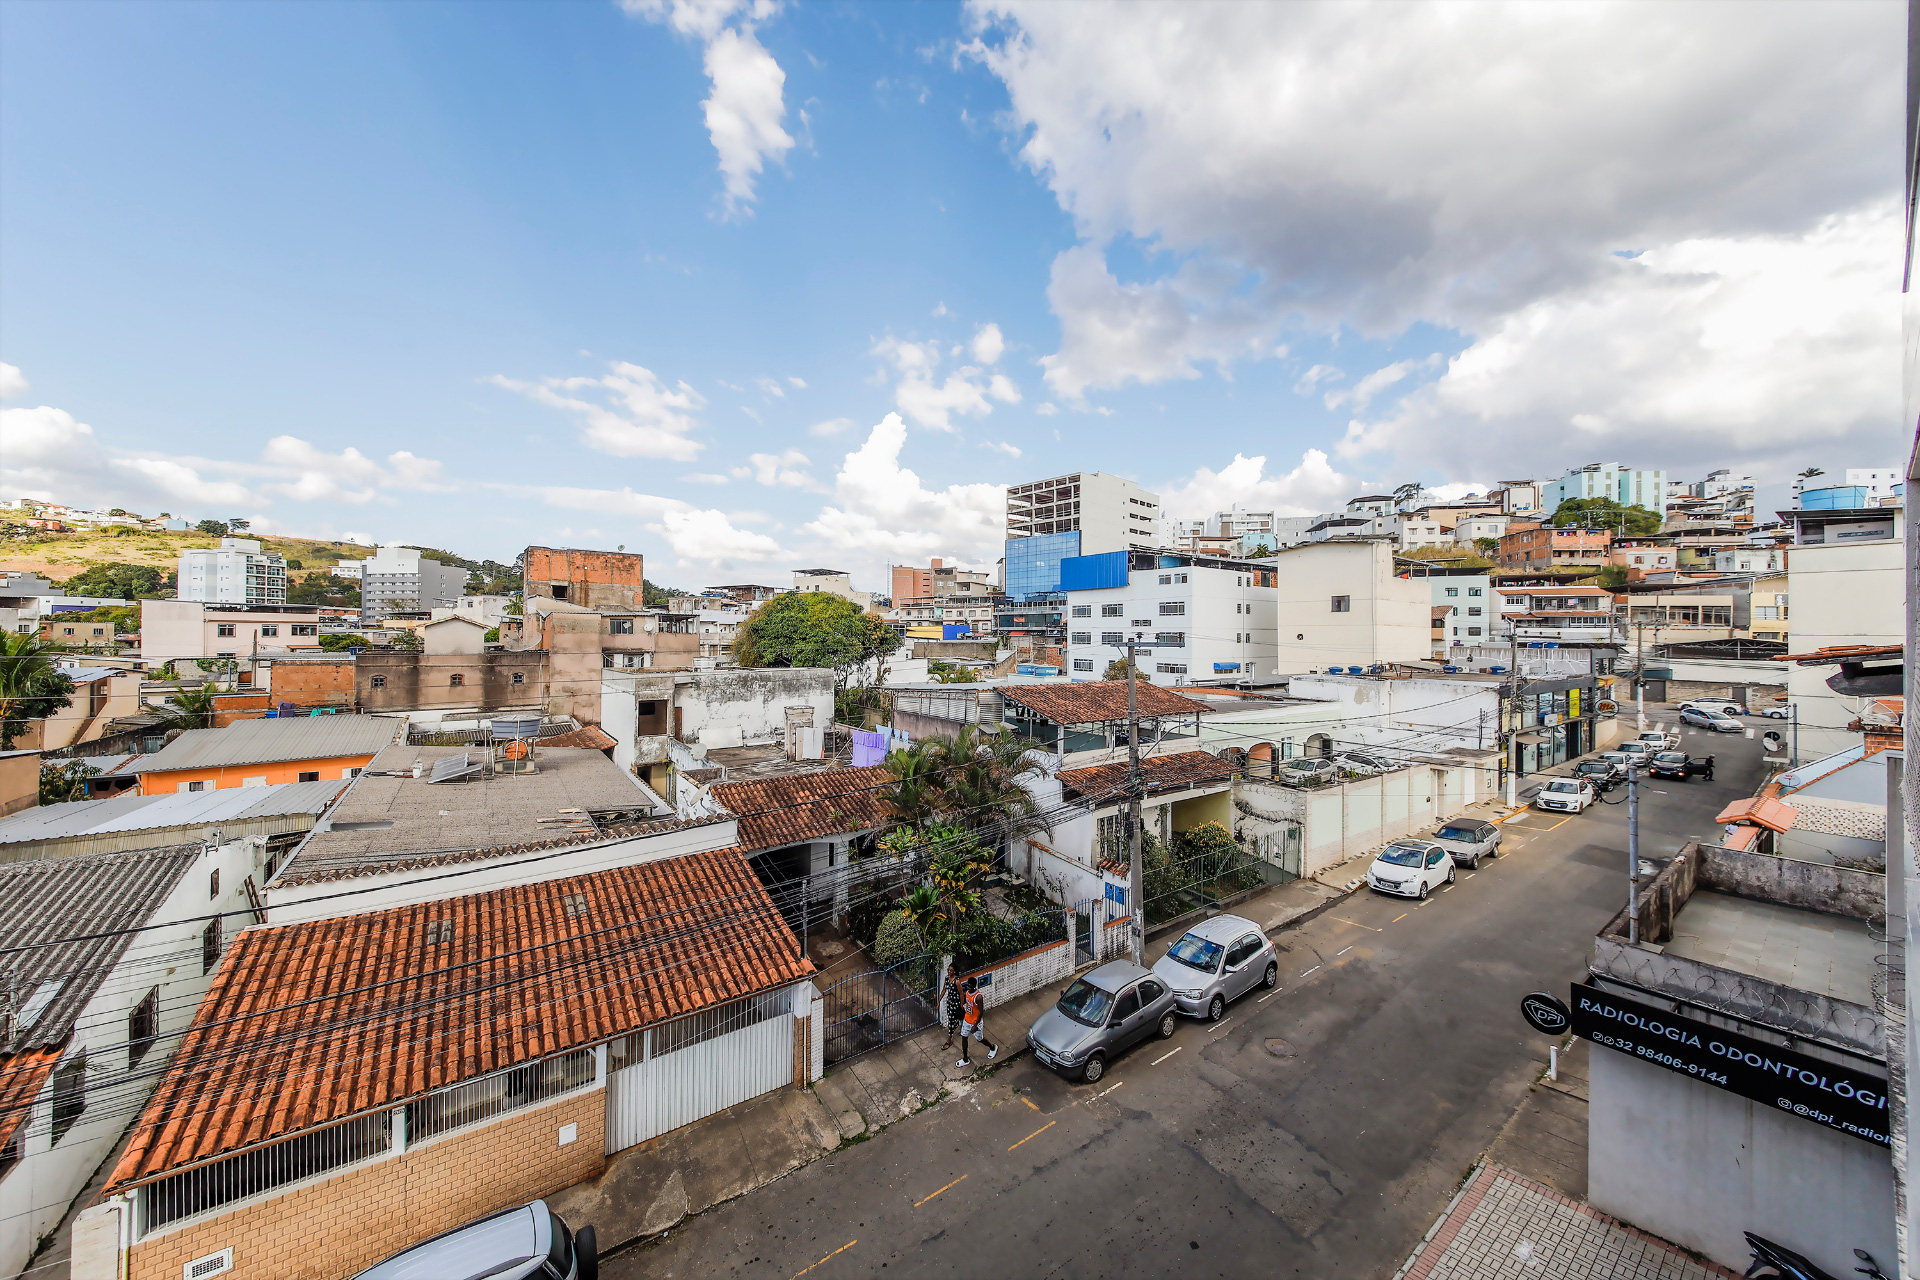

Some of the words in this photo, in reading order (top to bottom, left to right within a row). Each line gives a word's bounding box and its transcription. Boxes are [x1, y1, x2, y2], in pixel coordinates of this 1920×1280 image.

[1537, 1009, 1562, 1024] DPI
[1579, 998, 1701, 1049] RADIOLOGIA
[1709, 1041, 1889, 1110] ODONTOLÓGI
[1615, 1038, 1634, 1052] 32
[1637, 1045, 1728, 1085] 98406-9144
